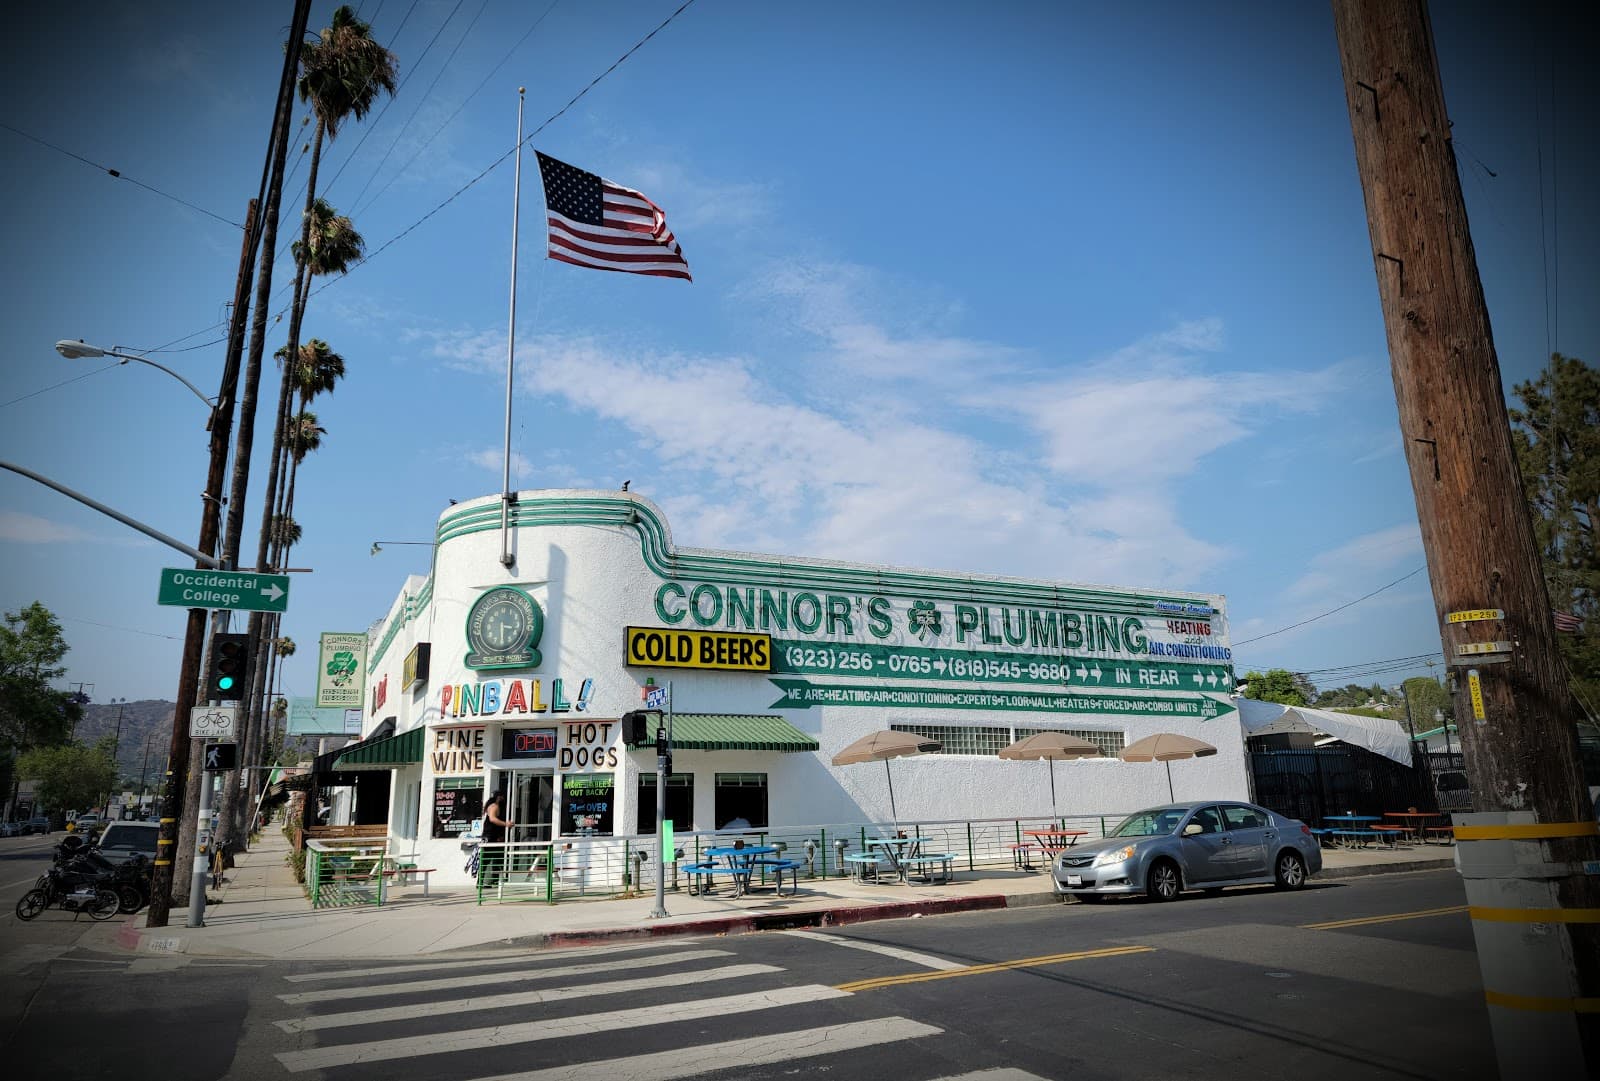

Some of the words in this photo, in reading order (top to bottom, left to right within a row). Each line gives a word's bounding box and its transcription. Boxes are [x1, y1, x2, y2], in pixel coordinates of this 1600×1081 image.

[173, 573, 257, 589] Occidental
[182, 588, 240, 606] College
[655, 582, 893, 638] CONNOR'S
[954, 603, 1150, 656] PLUMBING
[1166, 620, 1211, 635] HEATING
[631, 633, 693, 662] COLD
[700, 637, 767, 666] BEERS
[1149, 641, 1165, 655] AIR
[1166, 643, 1231, 660] CONDITIONING
[1115, 668, 1131, 684] IN
[1139, 669, 1179, 686] REAR
[441, 678, 593, 719] PINBALL!
[787, 688, 801, 700] WE
[805, 689, 824, 701] ARE
[829, 689, 870, 702] HEATING
[1175, 702, 1198, 713] UNITS
[435, 729, 485, 750] FINE
[516, 734, 554, 750] OPEN
[567, 724, 612, 746] HOT
[432, 751, 485, 774] WINE
[559, 746, 618, 771] DOGS
[570, 789, 583, 797] OUT
[586, 802, 607, 812] OVER
